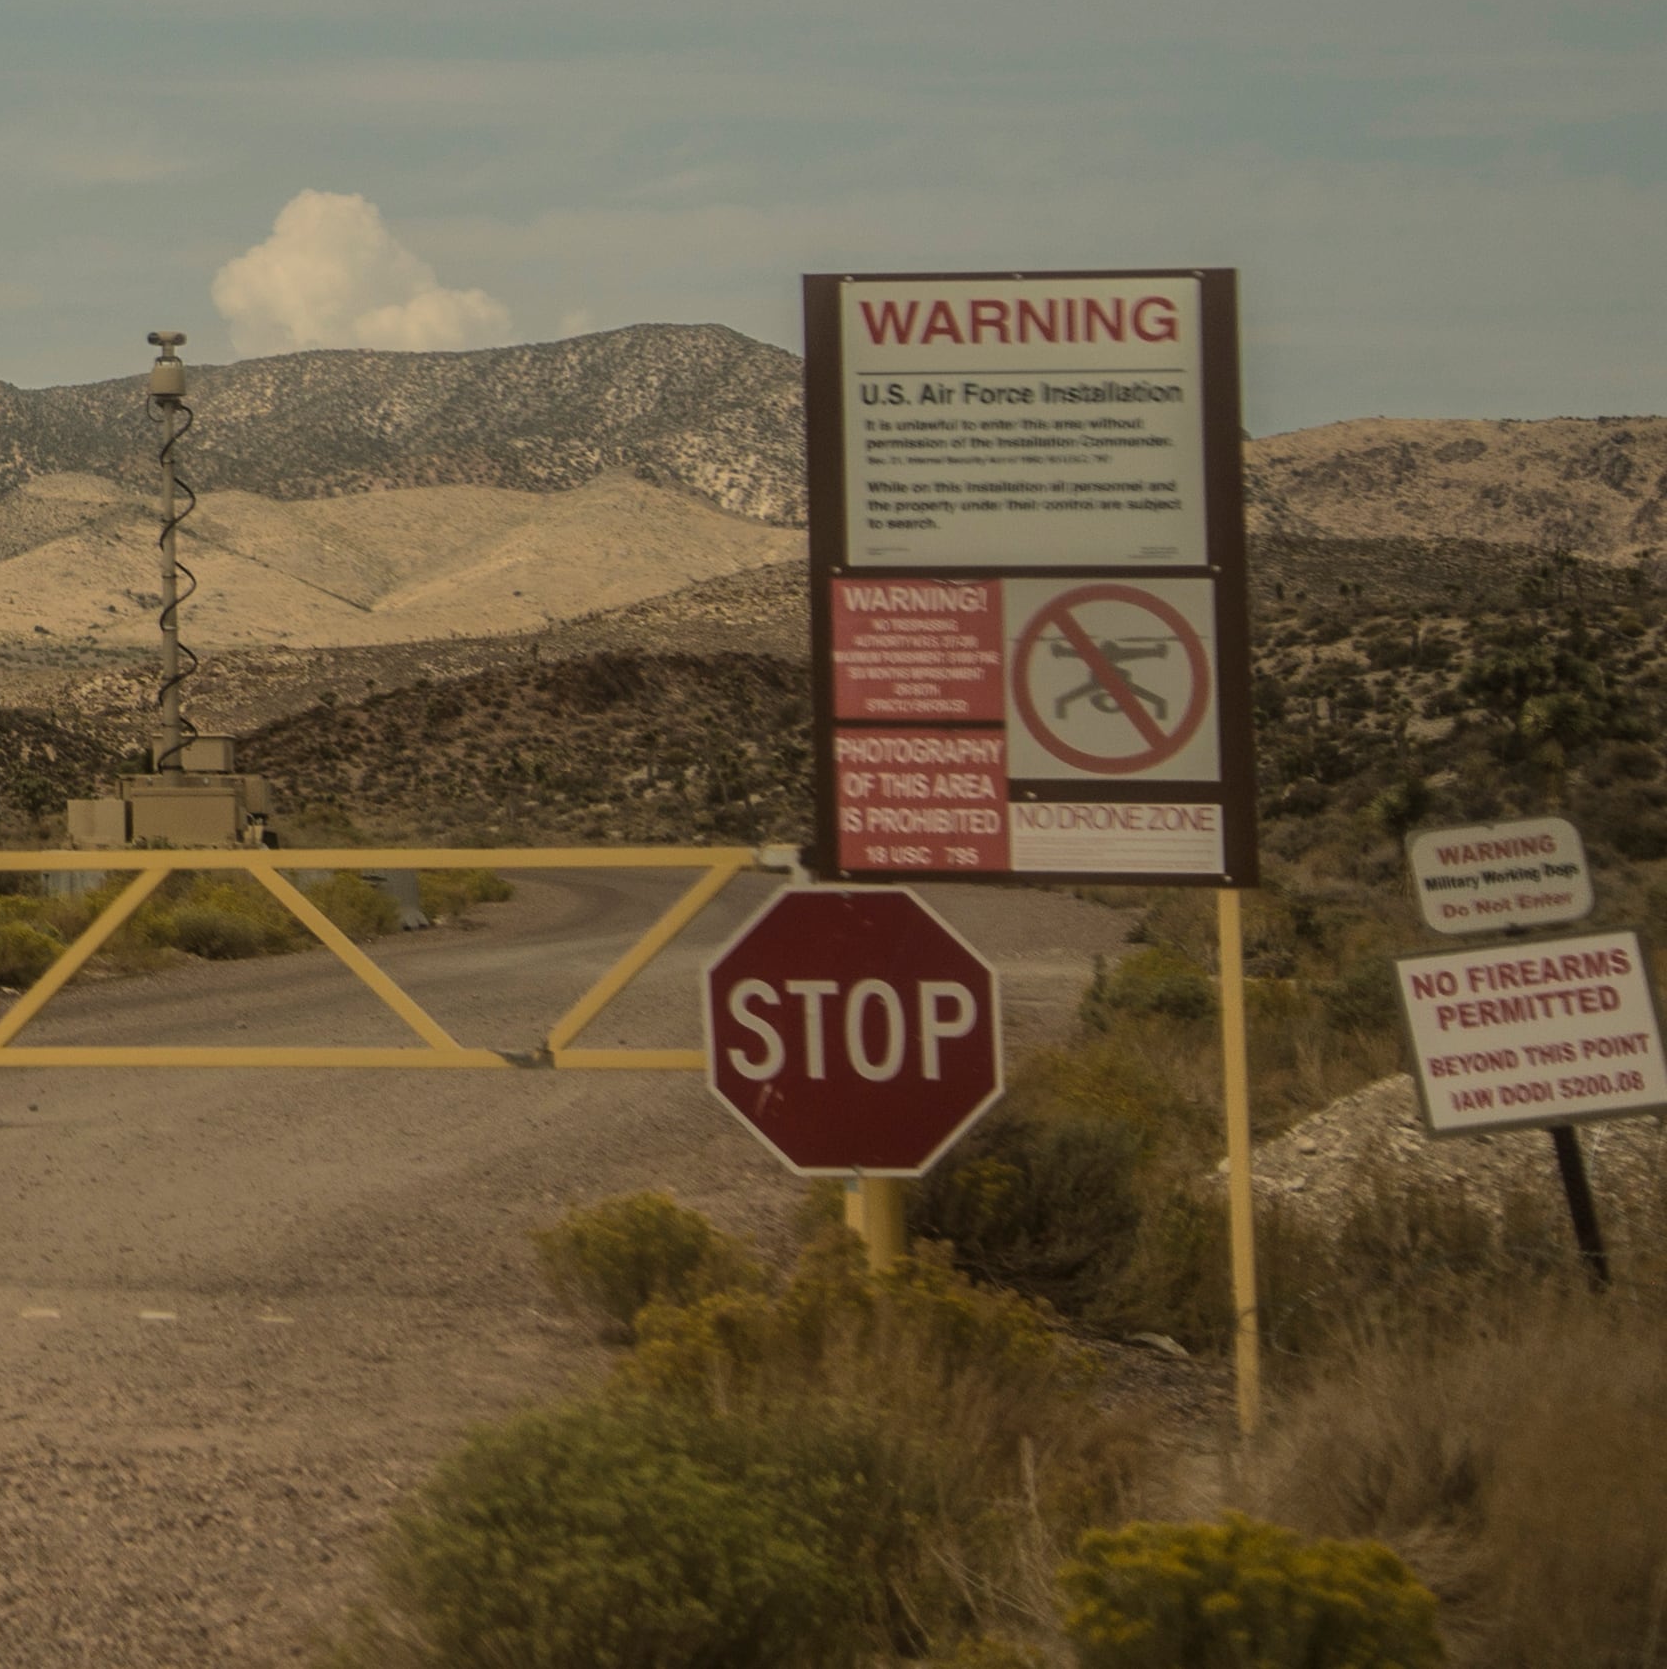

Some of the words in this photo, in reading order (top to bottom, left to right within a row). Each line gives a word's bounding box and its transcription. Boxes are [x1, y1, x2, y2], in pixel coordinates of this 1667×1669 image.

[859, 296, 1180, 345] WARNING
[861, 383, 911, 405] U.S.
[920, 382, 955, 404] Air
[962, 382, 1034, 404] Force
[1041, 380, 1183, 403] Installation
[843, 586, 987, 612] WARNING!
[835, 737, 1003, 764] PHOTOGRAPHY
[842, 771, 876, 799] OF
[877, 771, 931, 799] THIS
[932, 772, 996, 799] AREA
[839, 805, 863, 833] IS
[866, 806, 1001, 834] PROHIBITED
[1016, 805, 1054, 831] NO
[1056, 805, 1143, 831] DRONE
[1147, 805, 1215, 832] ZONE
[890, 845, 932, 865] USC
[1436, 834, 1557, 866] WARNING
[1424, 875, 1480, 892] Military
[1481, 867, 1542, 884] Working
[1541, 862, 1579, 880] Dogs
[1442, 903, 1468, 919] Do
[1473, 898, 1511, 915] Not
[1515, 891, 1572, 911] Enter
[1411, 970, 1458, 1000] NO
[1465, 948, 1631, 993] FIREARMS
[1436, 985, 1621, 1032] PERMITTED
[726, 978, 978, 1081] STOP
[1427, 1049, 1519, 1078] BEYOND
[1521, 1042, 1577, 1067] THIS
[1580, 1033, 1649, 1060] POINT
[1451, 1088, 1494, 1112] IAW
[1498, 1081, 1555, 1107] DODI
